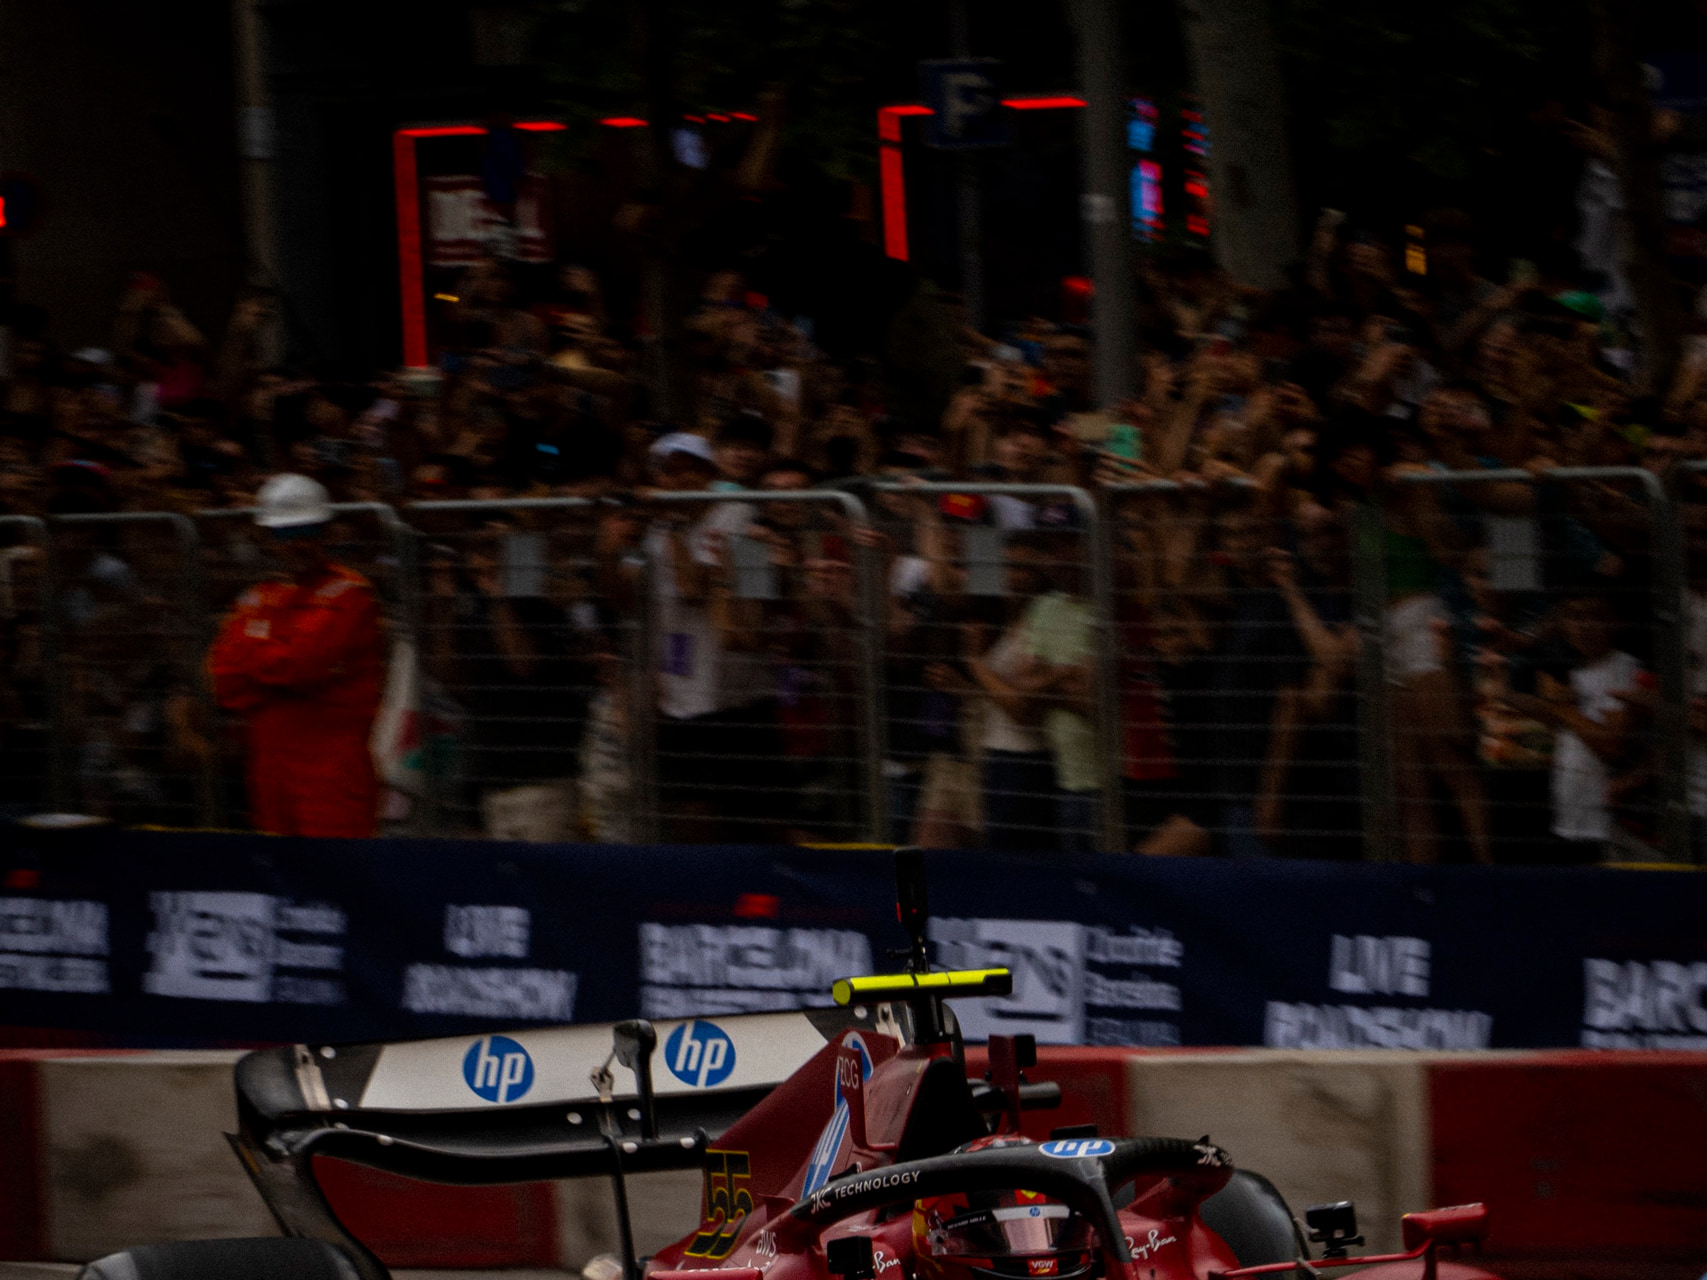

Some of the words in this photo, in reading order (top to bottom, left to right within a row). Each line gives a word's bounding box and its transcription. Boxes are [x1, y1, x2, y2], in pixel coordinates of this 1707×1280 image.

[470, 1036, 530, 1102] hp
[671, 1020, 732, 1087] hp
[684, 1148, 755, 1261] 55
[835, 1170, 921, 1199] TECHNOLOGY
